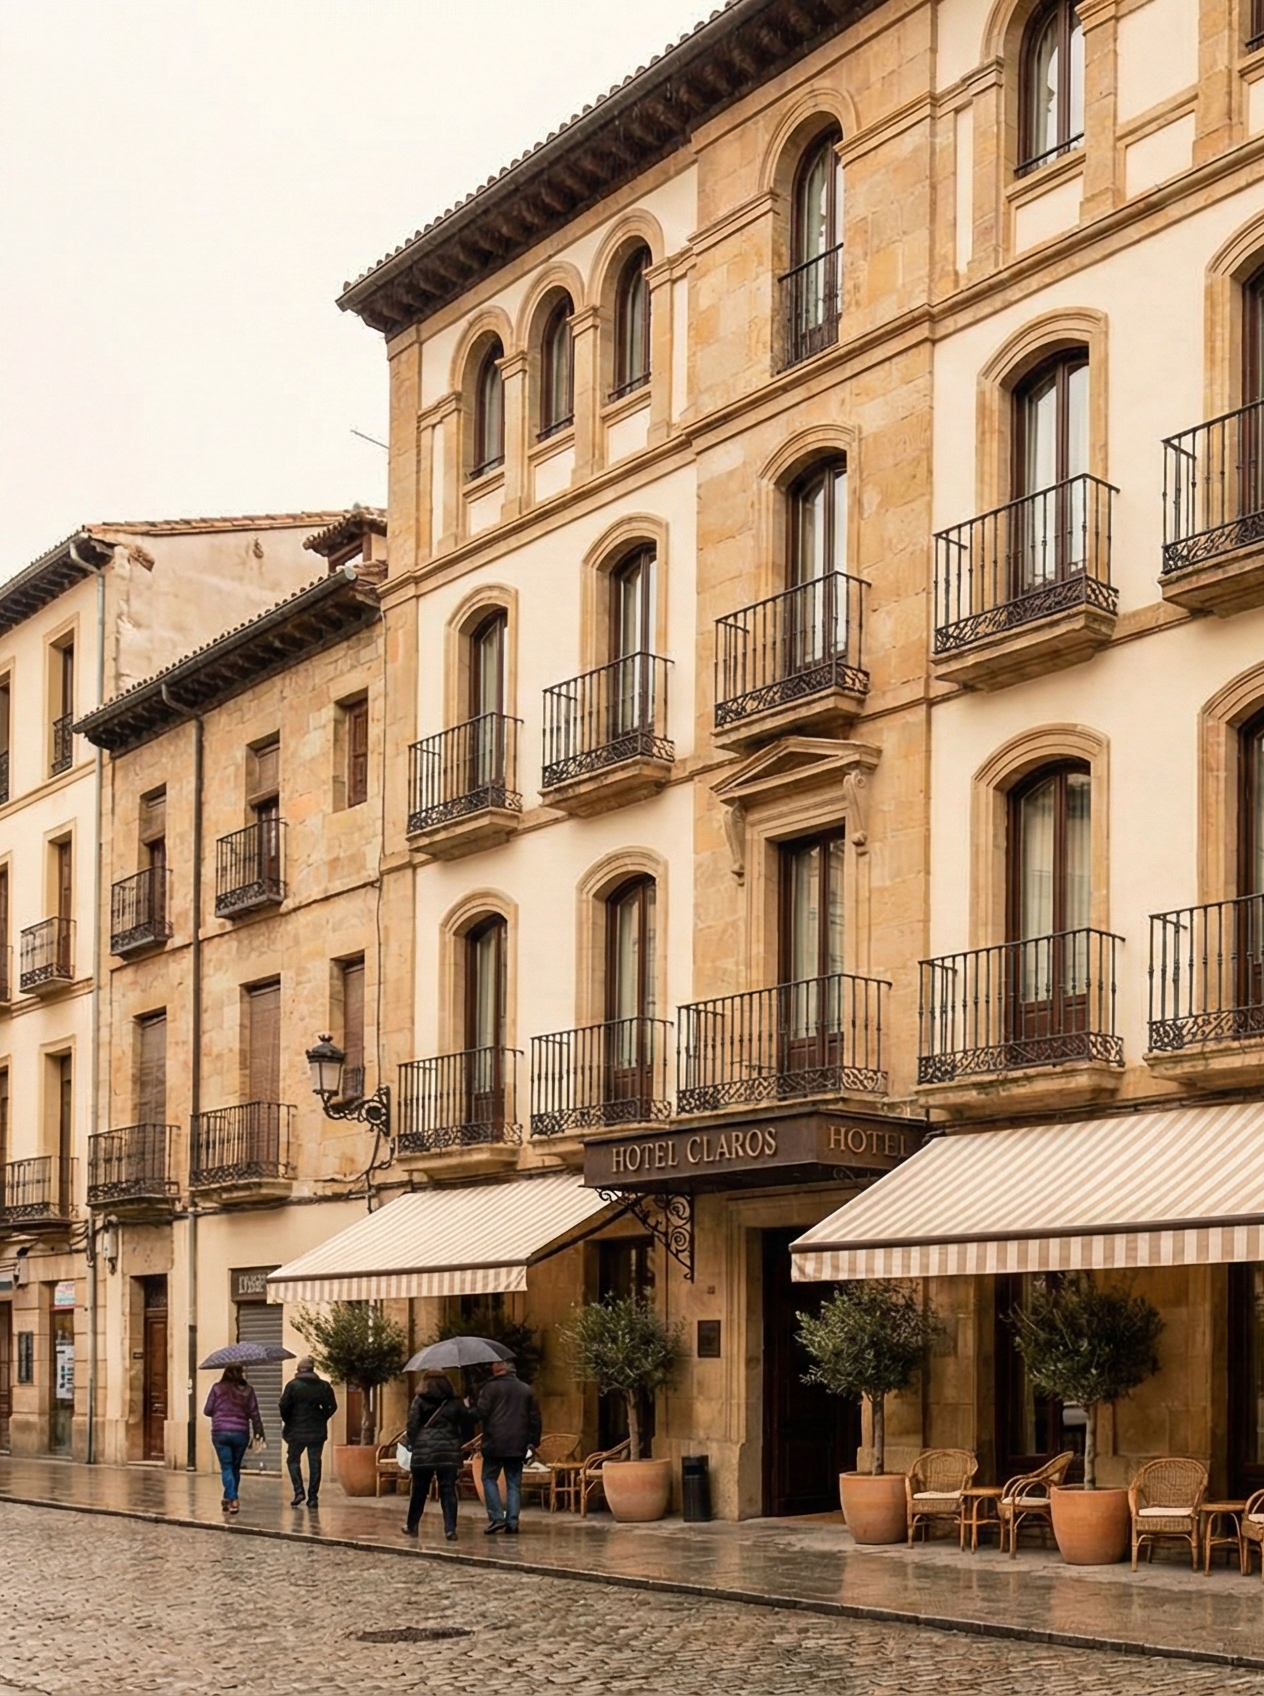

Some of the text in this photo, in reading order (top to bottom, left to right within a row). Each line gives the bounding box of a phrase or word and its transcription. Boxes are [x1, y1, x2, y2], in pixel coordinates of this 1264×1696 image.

[611, 1127, 777, 1173] HOTEL CLAROS
[828, 1124, 910, 1158] HOTEL
